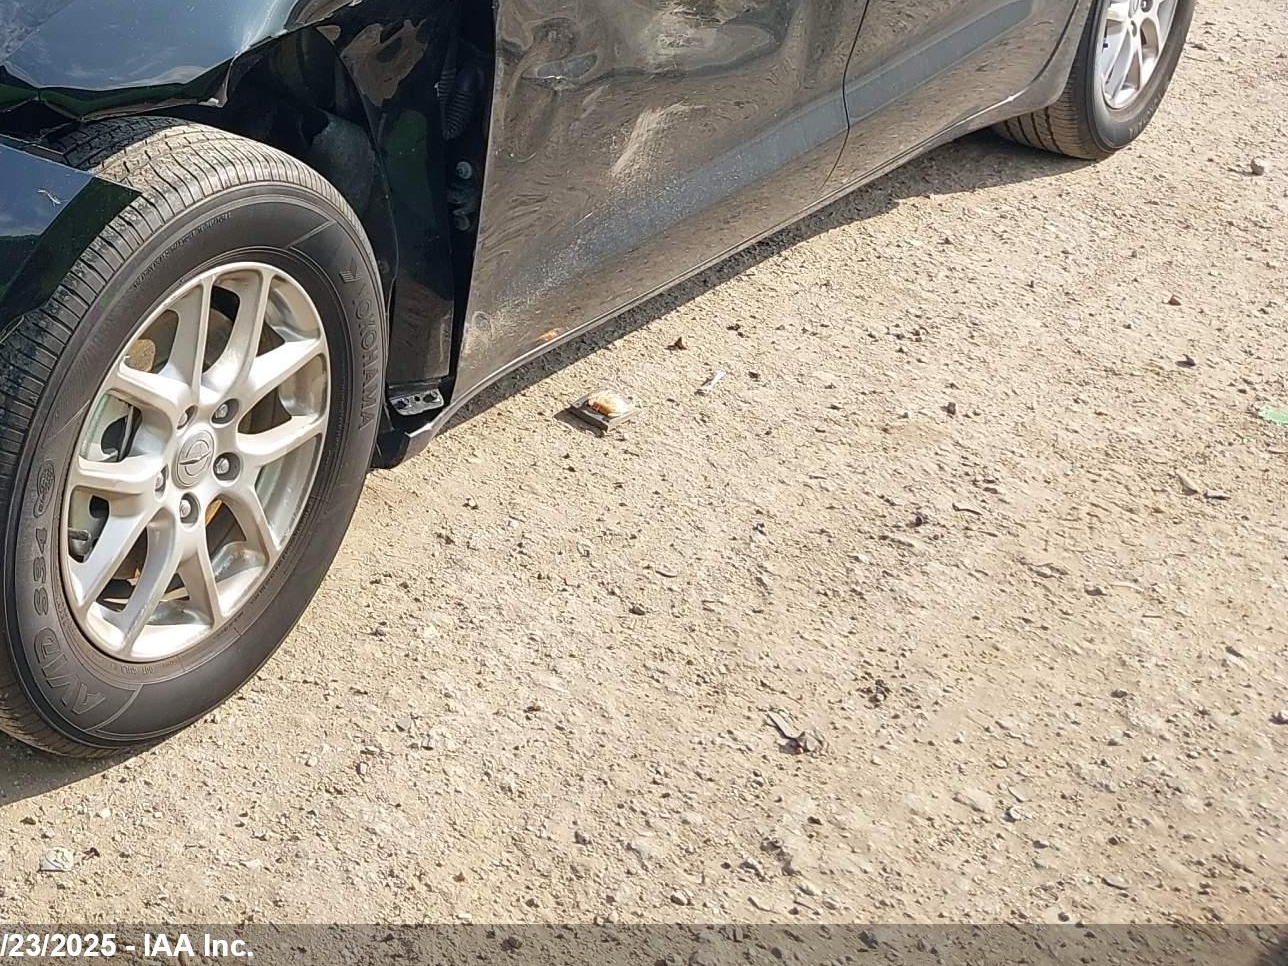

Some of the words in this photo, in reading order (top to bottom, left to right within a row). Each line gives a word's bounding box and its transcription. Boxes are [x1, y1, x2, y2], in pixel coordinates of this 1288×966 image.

[351, 284, 379, 431] YOKOHAMA
[32, 527, 50, 617] S34
[33, 627, 105, 715] AVID
